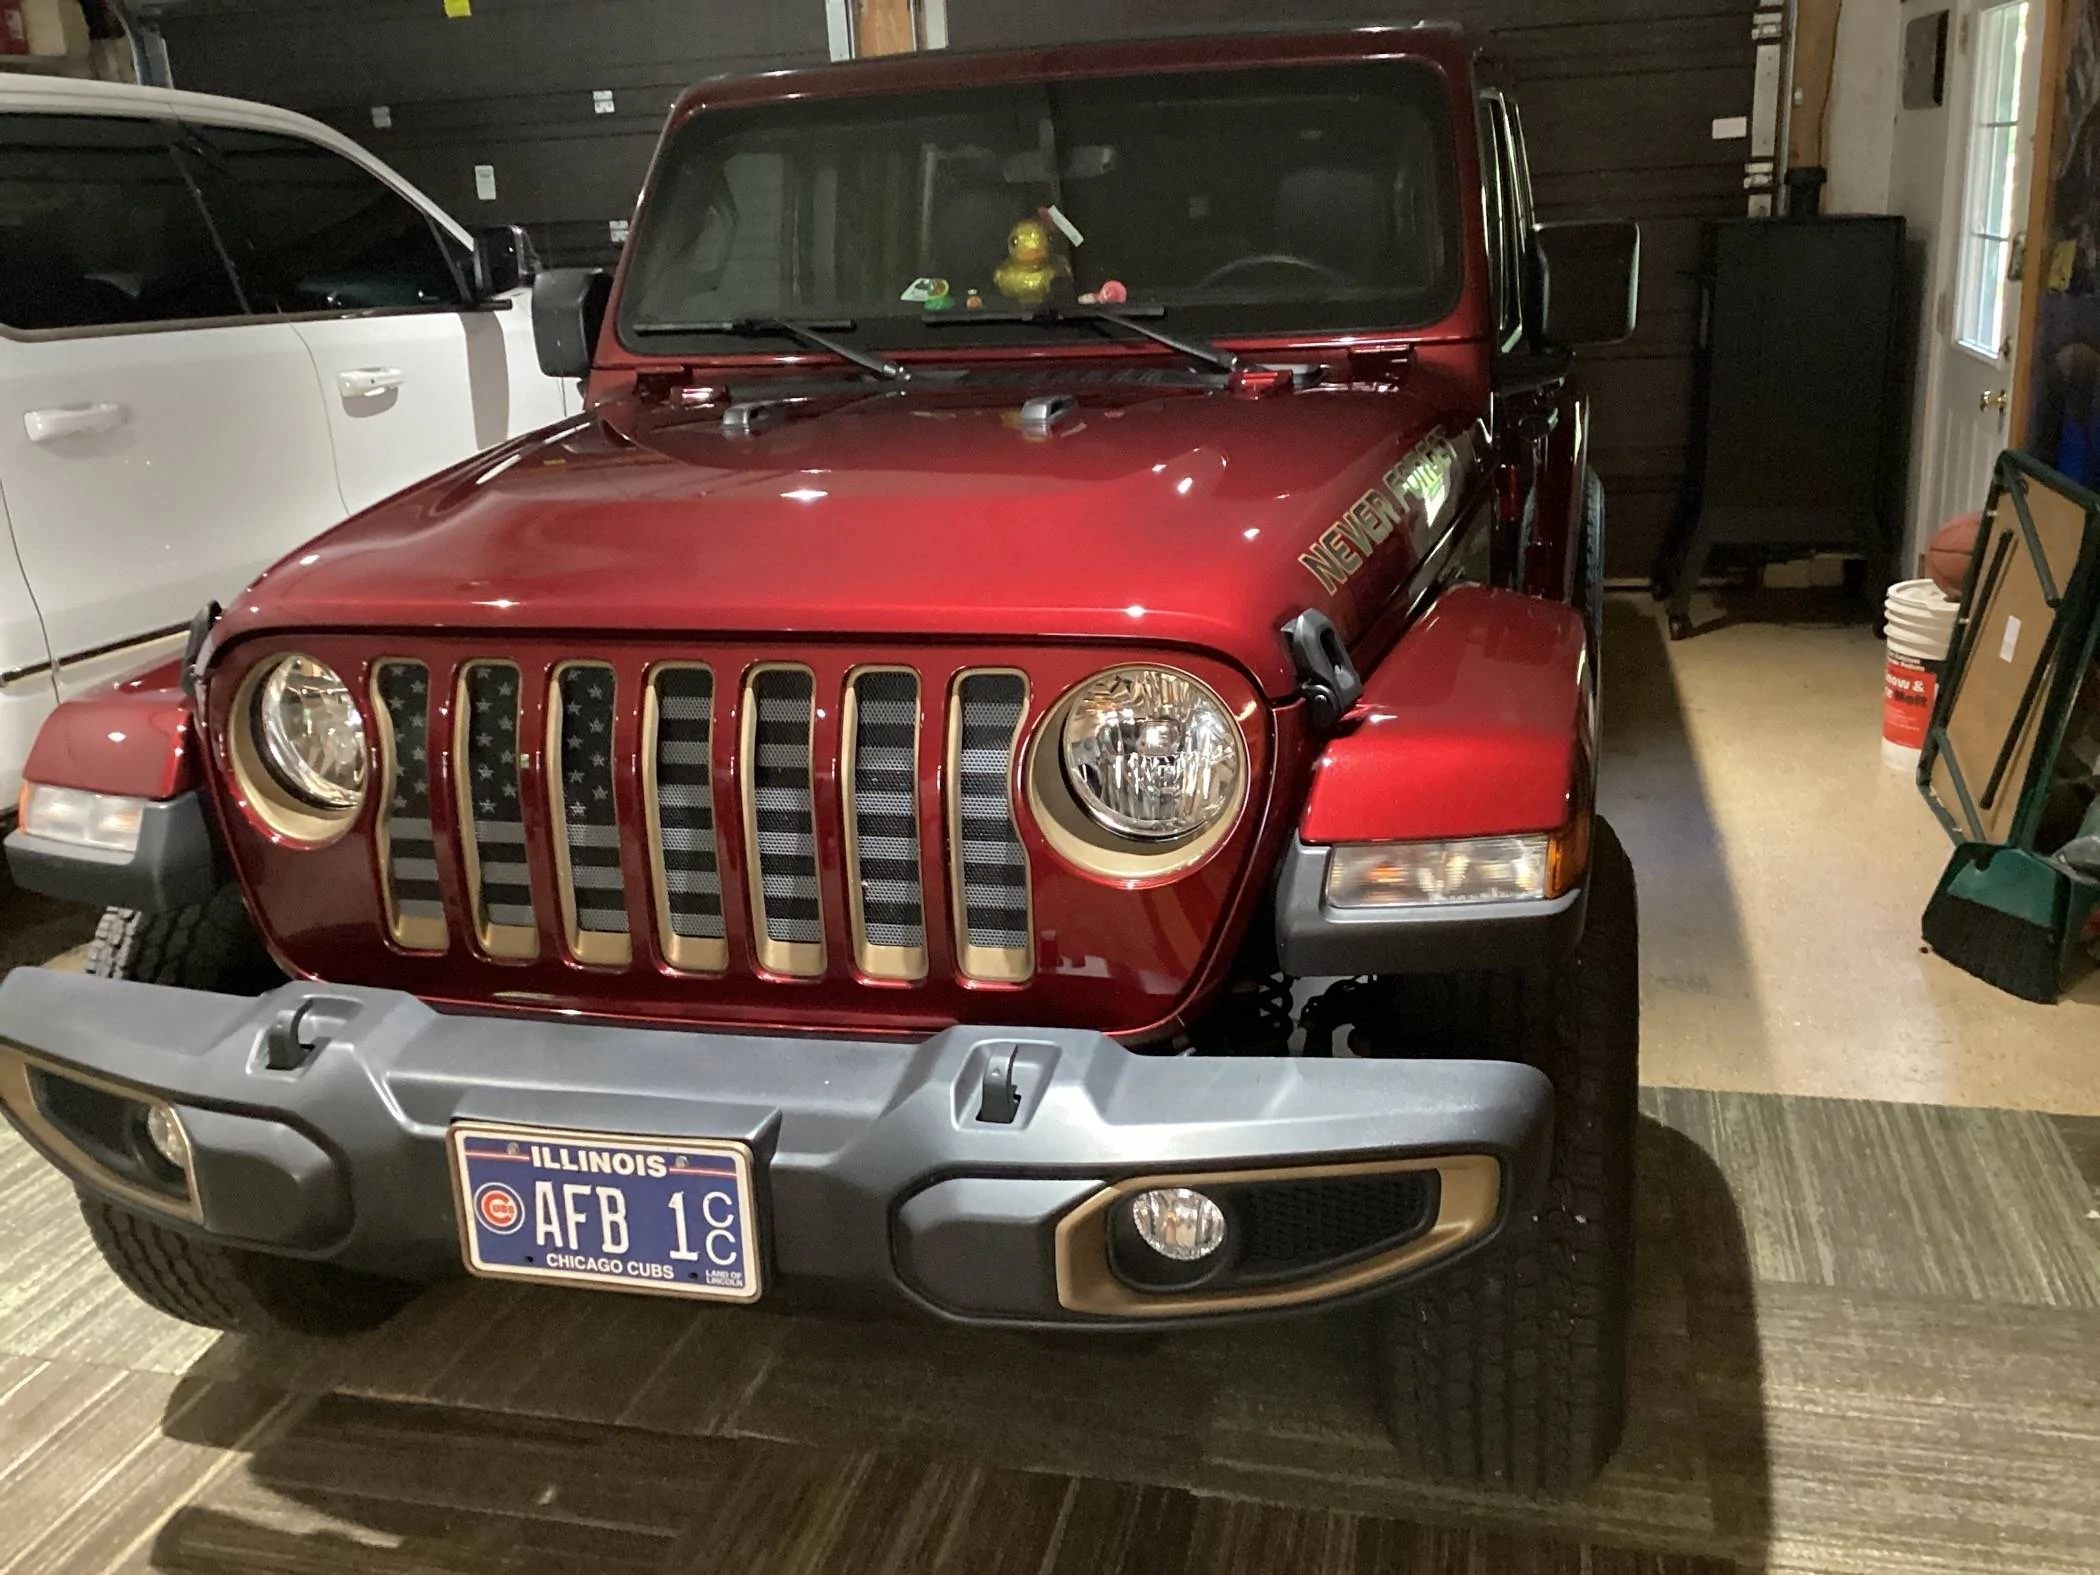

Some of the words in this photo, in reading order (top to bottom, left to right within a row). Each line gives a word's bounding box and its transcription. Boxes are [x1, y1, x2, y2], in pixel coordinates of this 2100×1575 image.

[1298, 488, 1401, 597] NEVER
[1885, 671, 1910, 690] now
[1912, 680, 1925, 693] &
[531, 1146, 667, 1177] ILLINOIS
[535, 1181, 629, 1254] AFB
[668, 1190, 698, 1261] 1
[546, 1253, 623, 1274] CHICAGO
[627, 1261, 674, 1280] CUBS
[705, 1269, 728, 1278] LAND
[731, 1271, 742, 1279] OF
[706, 1277, 743, 1287] LINCOLN
